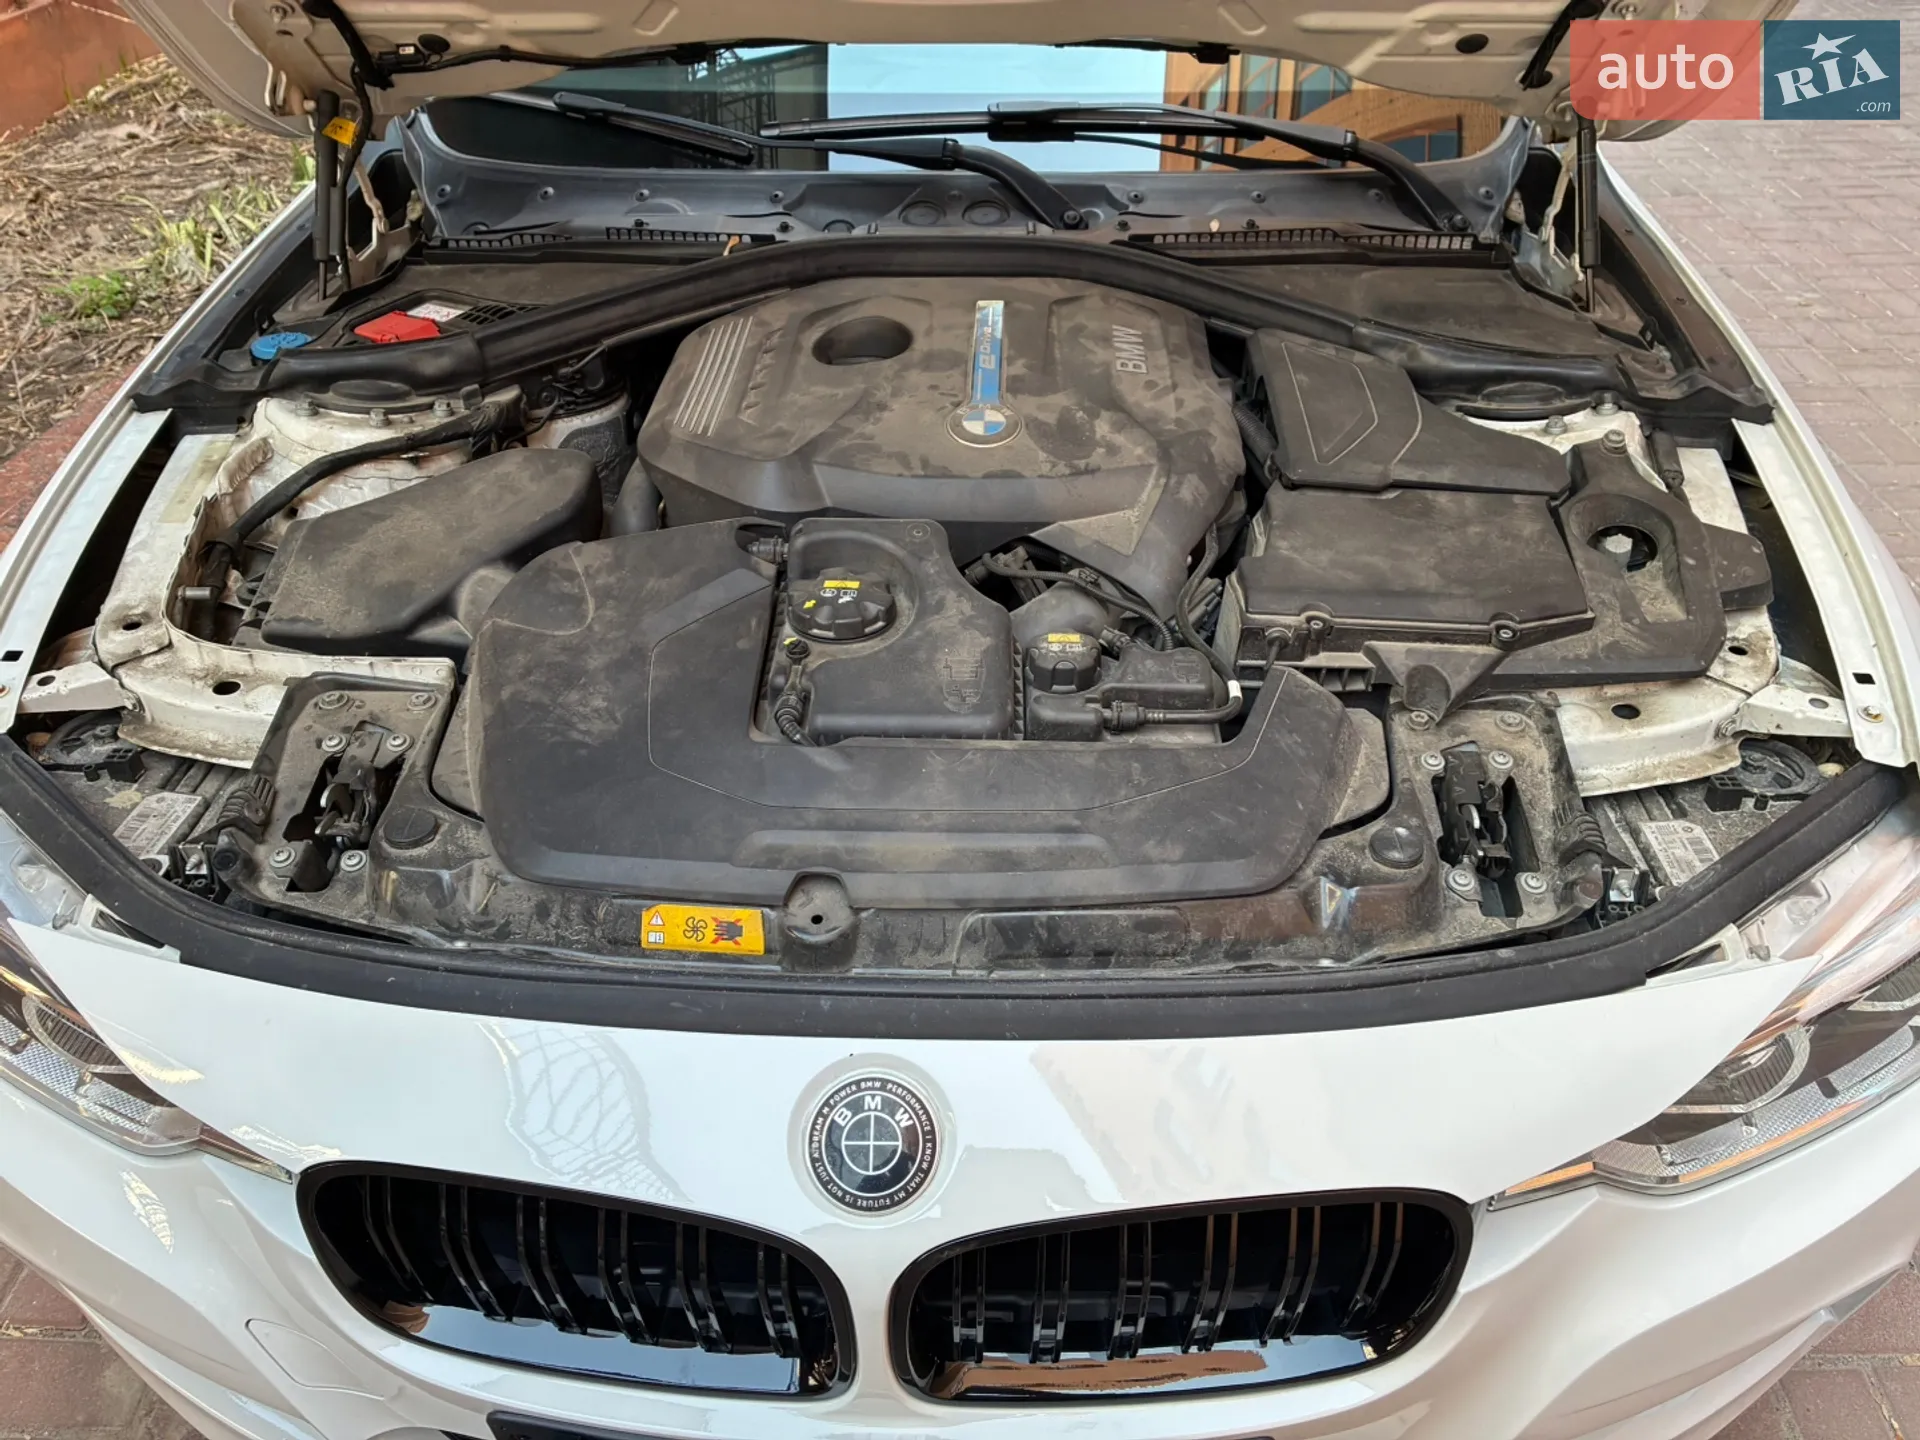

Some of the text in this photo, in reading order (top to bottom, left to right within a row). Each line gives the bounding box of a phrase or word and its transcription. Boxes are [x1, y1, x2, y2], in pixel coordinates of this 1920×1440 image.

[1112, 324, 1148, 374] BMW
[829, 1084, 857, 1105] POWER
[860, 1081, 882, 1089] BMW
[822, 1106, 830, 1115] M
[834, 1095, 914, 1128] BMW
[886, 1083, 931, 1131] PERFORMANCE
[811, 1117, 824, 1148] DREAM
[921, 1142, 933, 1170] KNOW
[815, 1162, 830, 1181] JUST
[827, 1183, 844, 1197] NOT
[906, 1172, 925, 1192] THAT
[844, 1195, 854, 1203] IS
[857, 1198, 891, 1208] FUTURE
[893, 1191, 906, 1201] MY
